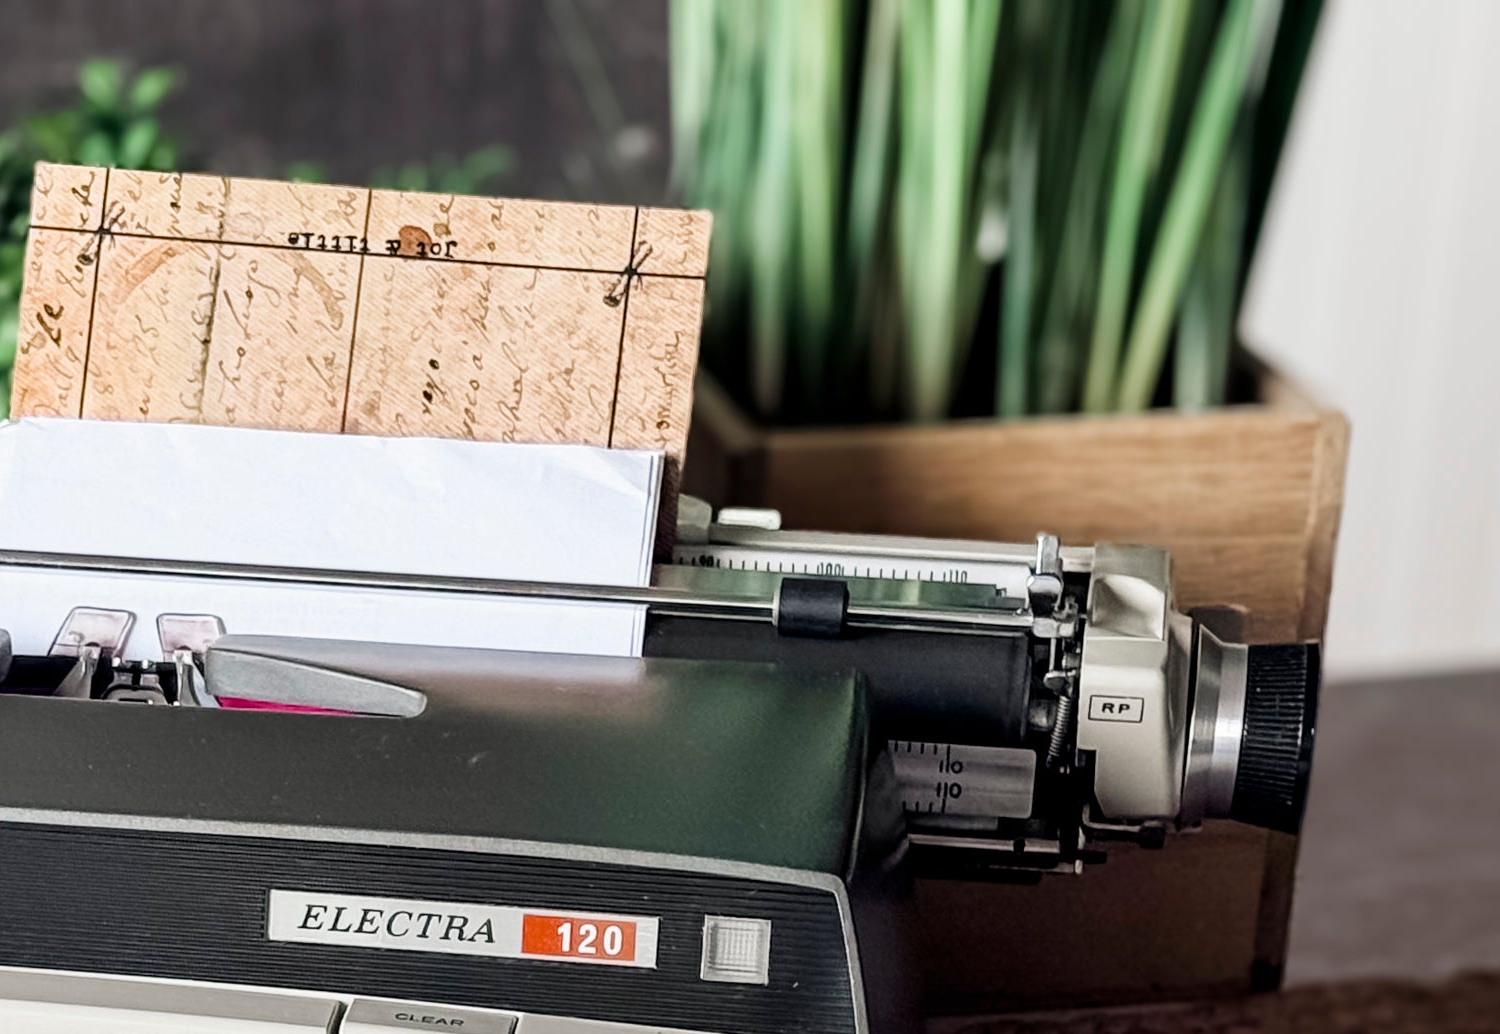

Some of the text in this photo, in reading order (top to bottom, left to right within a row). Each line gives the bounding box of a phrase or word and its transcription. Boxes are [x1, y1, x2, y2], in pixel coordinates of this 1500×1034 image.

[296, 903, 624, 956] ELECTRA 120
[394, 1011, 466, 1028] CLEAR
